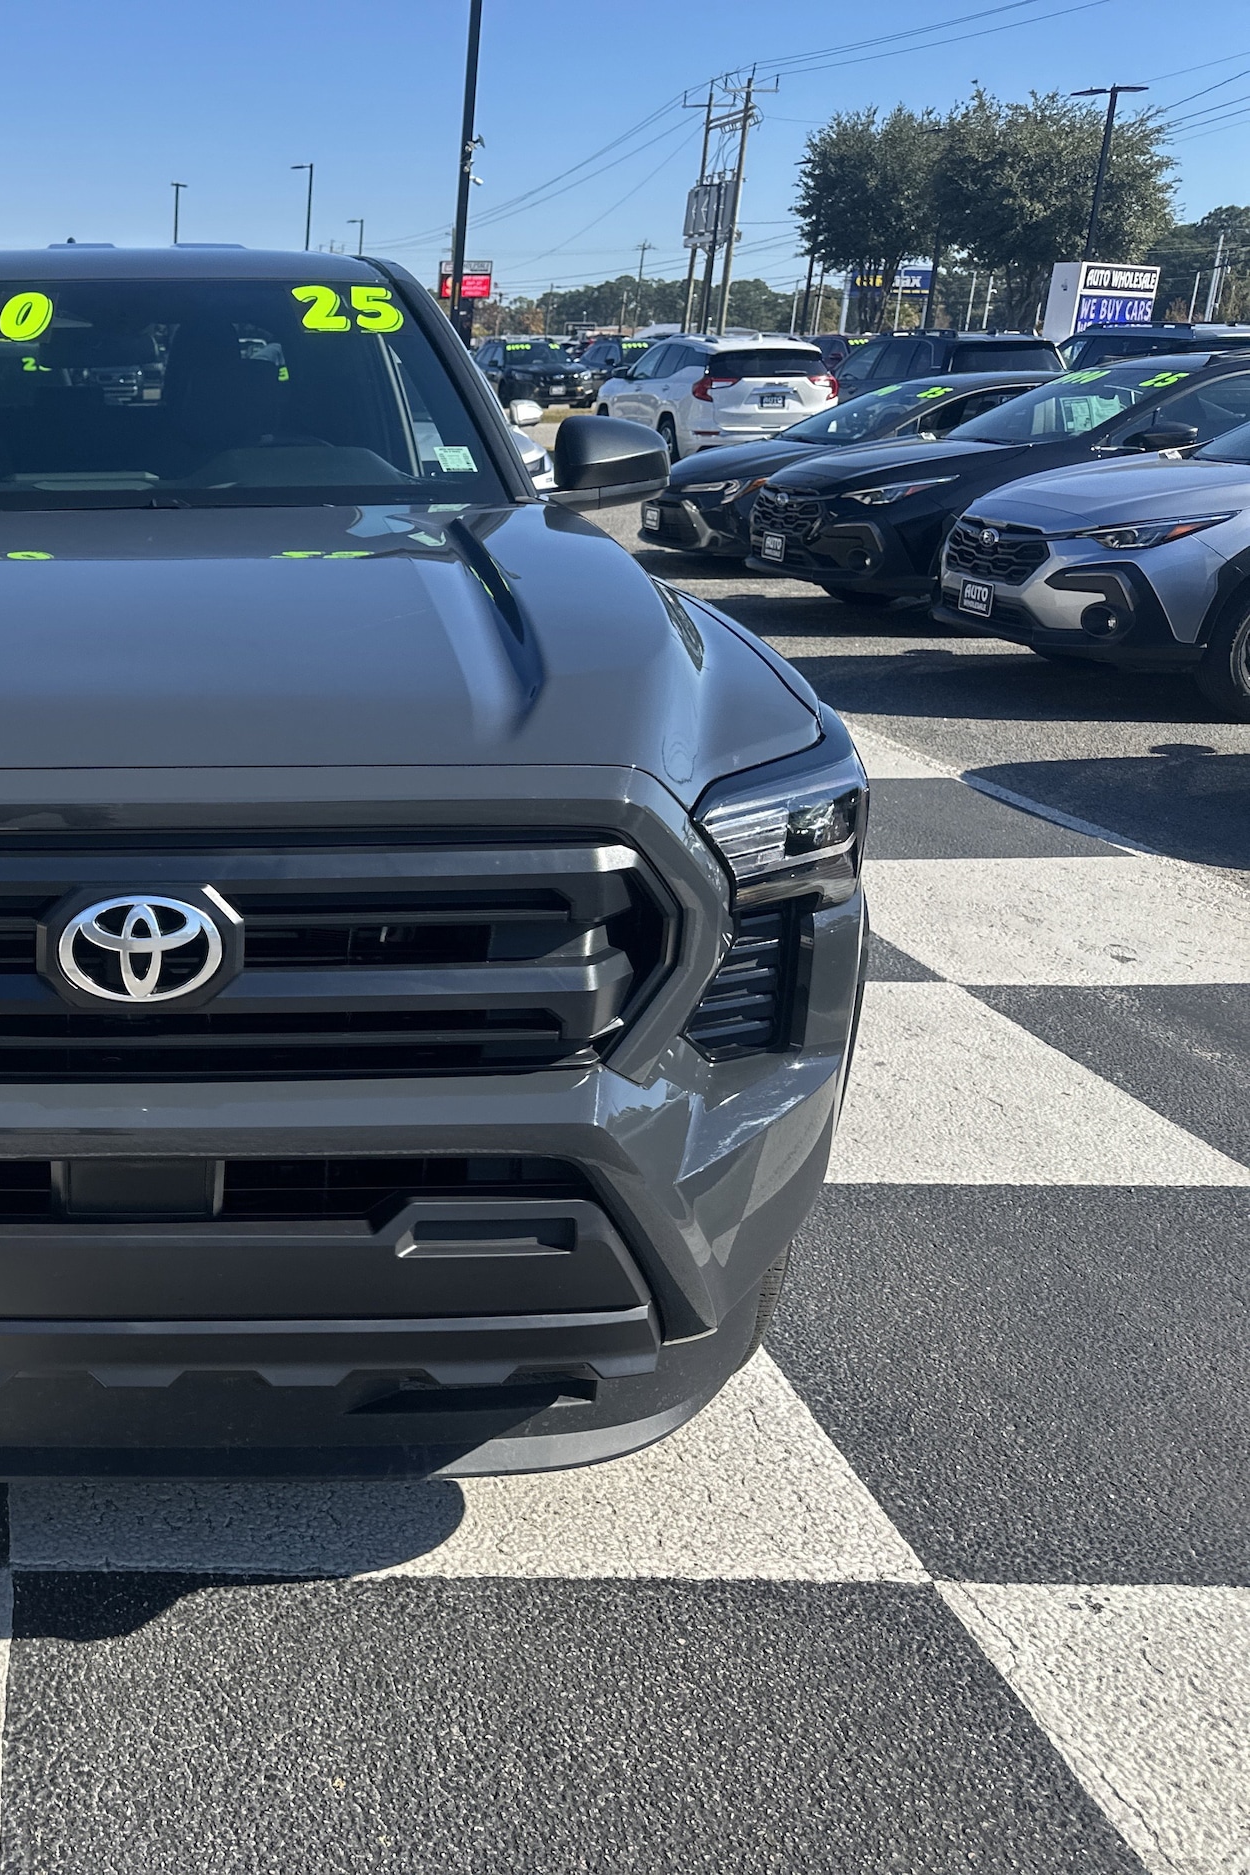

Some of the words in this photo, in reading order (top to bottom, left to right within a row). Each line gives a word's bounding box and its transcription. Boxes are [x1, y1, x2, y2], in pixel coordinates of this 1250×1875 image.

[1086, 269, 1111, 287] AUTO
[1111, 270, 1157, 290] WHOLESALE
[291, 285, 405, 333] 25
[1080, 298, 1097, 320] WE
[1099, 299, 1124, 321] BUY
[1125, 300, 1152, 322] CARS
[1138, 372, 1190, 388] 25
[765, 536, 783, 550] AUTO
[964, 583, 989, 602] AUTO
